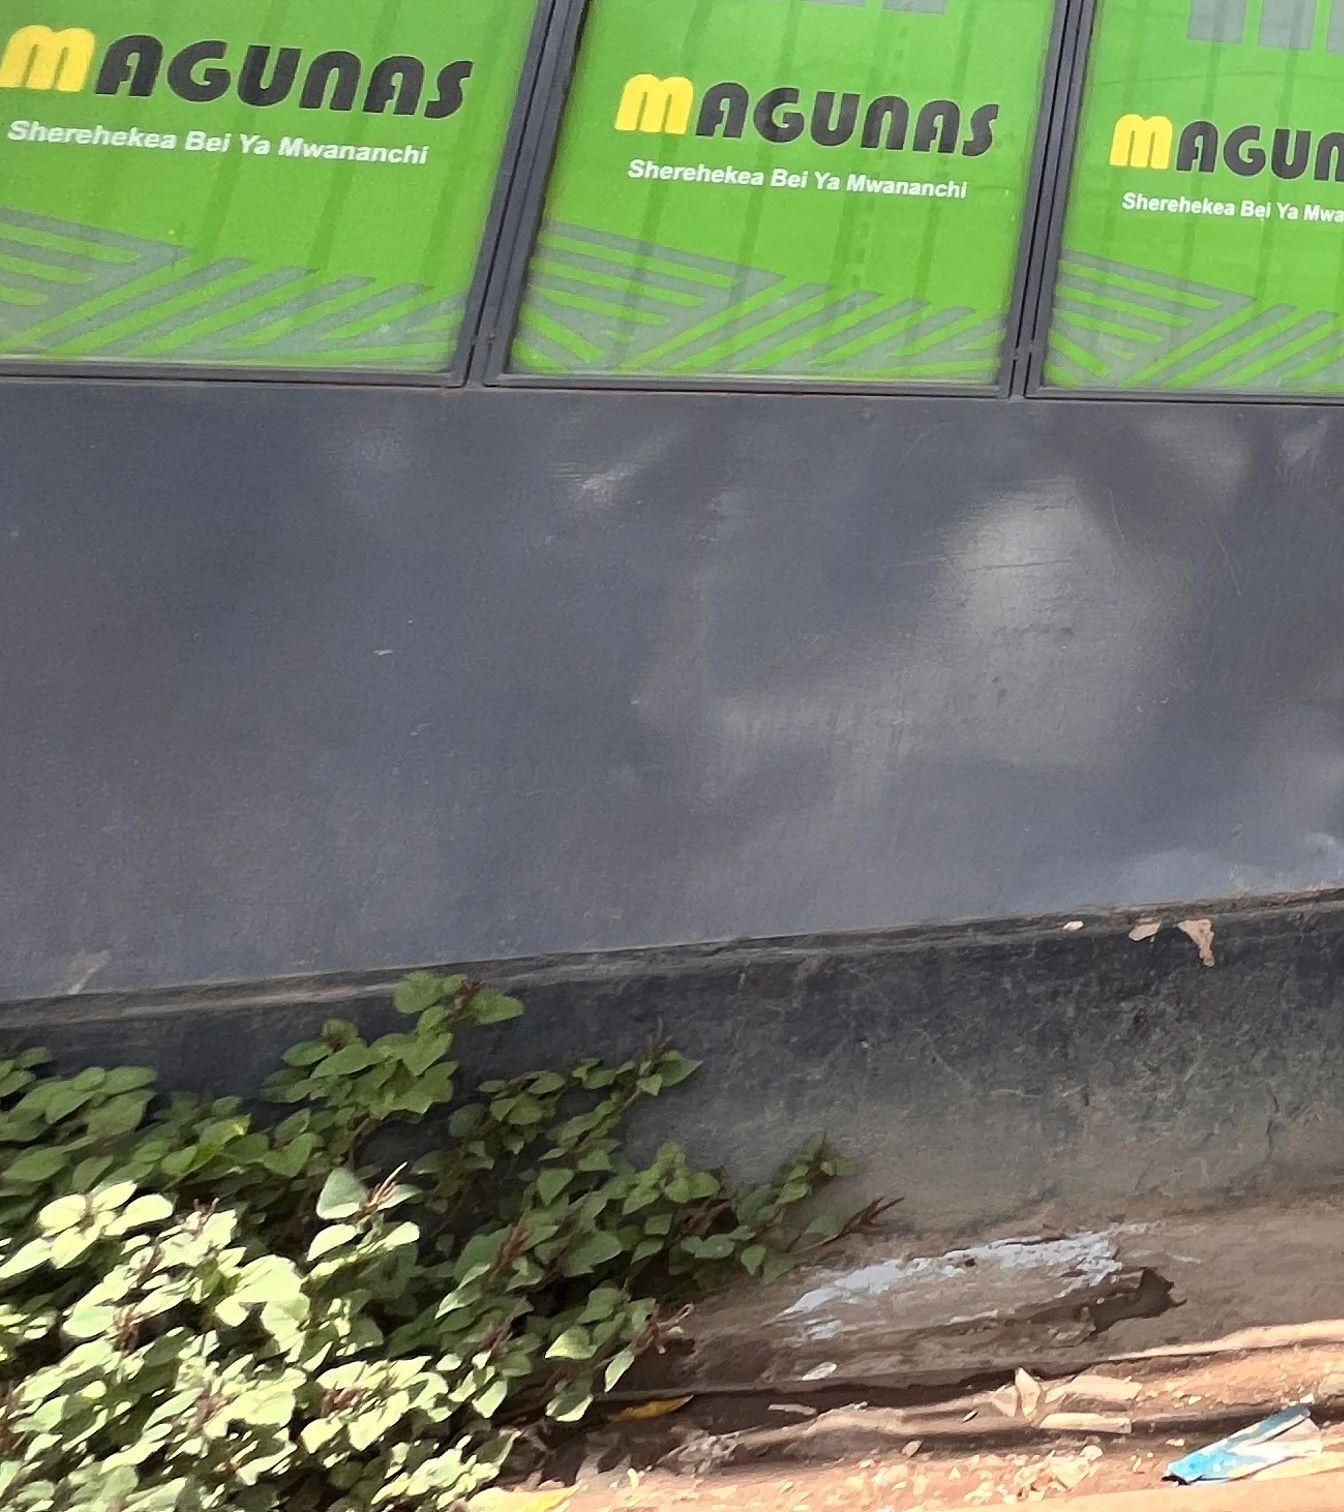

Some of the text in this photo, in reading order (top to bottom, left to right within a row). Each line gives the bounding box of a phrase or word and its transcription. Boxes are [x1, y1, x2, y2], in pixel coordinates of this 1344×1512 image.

[7, 120, 430, 165] Sherehekea Bei Ya Mwananchi
[627, 158, 968, 199] Sherehekea Bei Ya Mwananchi
[1121, 191, 1236, 216] Sherehekea
[1240, 199, 1271, 218] Bei
[1276, 202, 1299, 220] Ya
